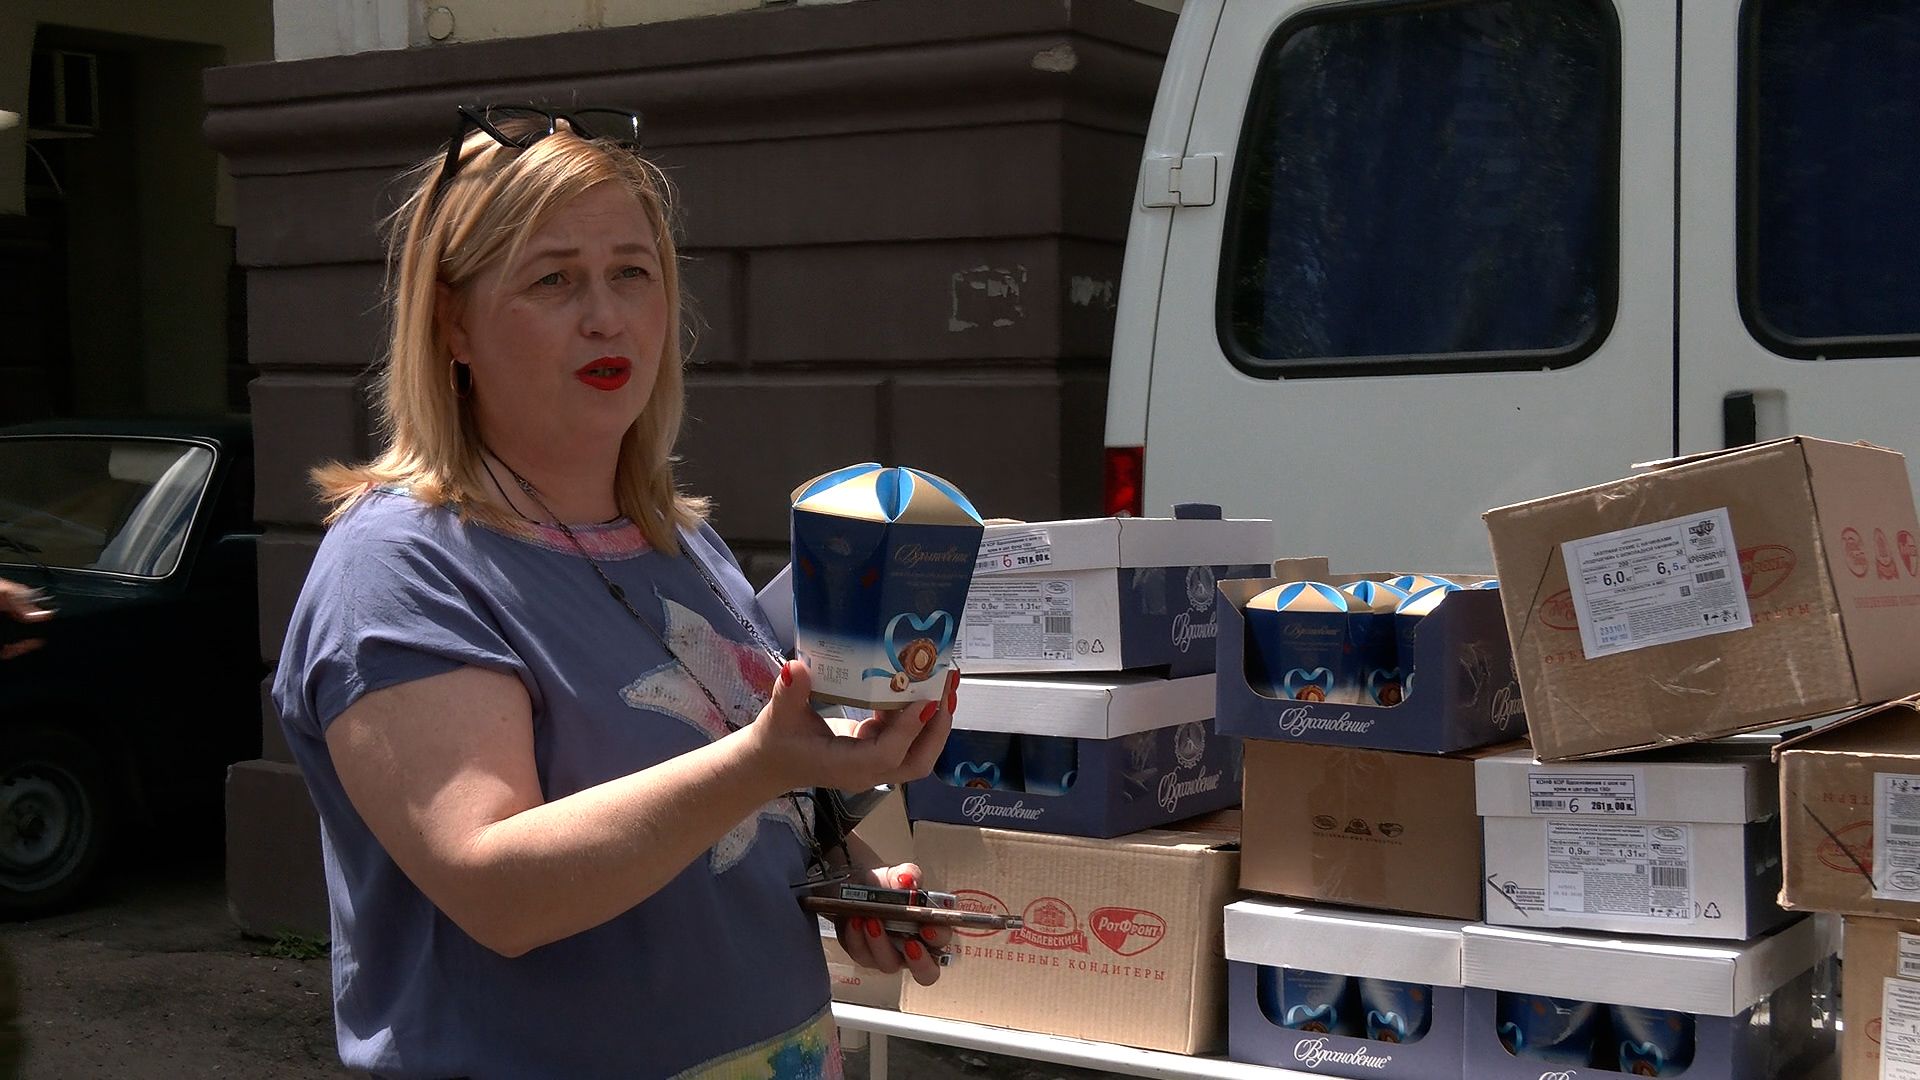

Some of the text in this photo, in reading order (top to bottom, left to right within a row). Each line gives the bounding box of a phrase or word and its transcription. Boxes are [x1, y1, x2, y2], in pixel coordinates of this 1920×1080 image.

[1003, 555, 1012, 568] 6
[1017, 556, 1028, 564] 261
[1603, 570, 1625, 587] 6,0
[1569, 798, 1579, 813] 6
[1591, 801, 1605, 810] 261
[1614, 802, 1625, 811] 00
[1068, 960, 1165, 981] КОНДИТЕРЫ
[1293, 1037, 1388, 1069] Вдохновение
